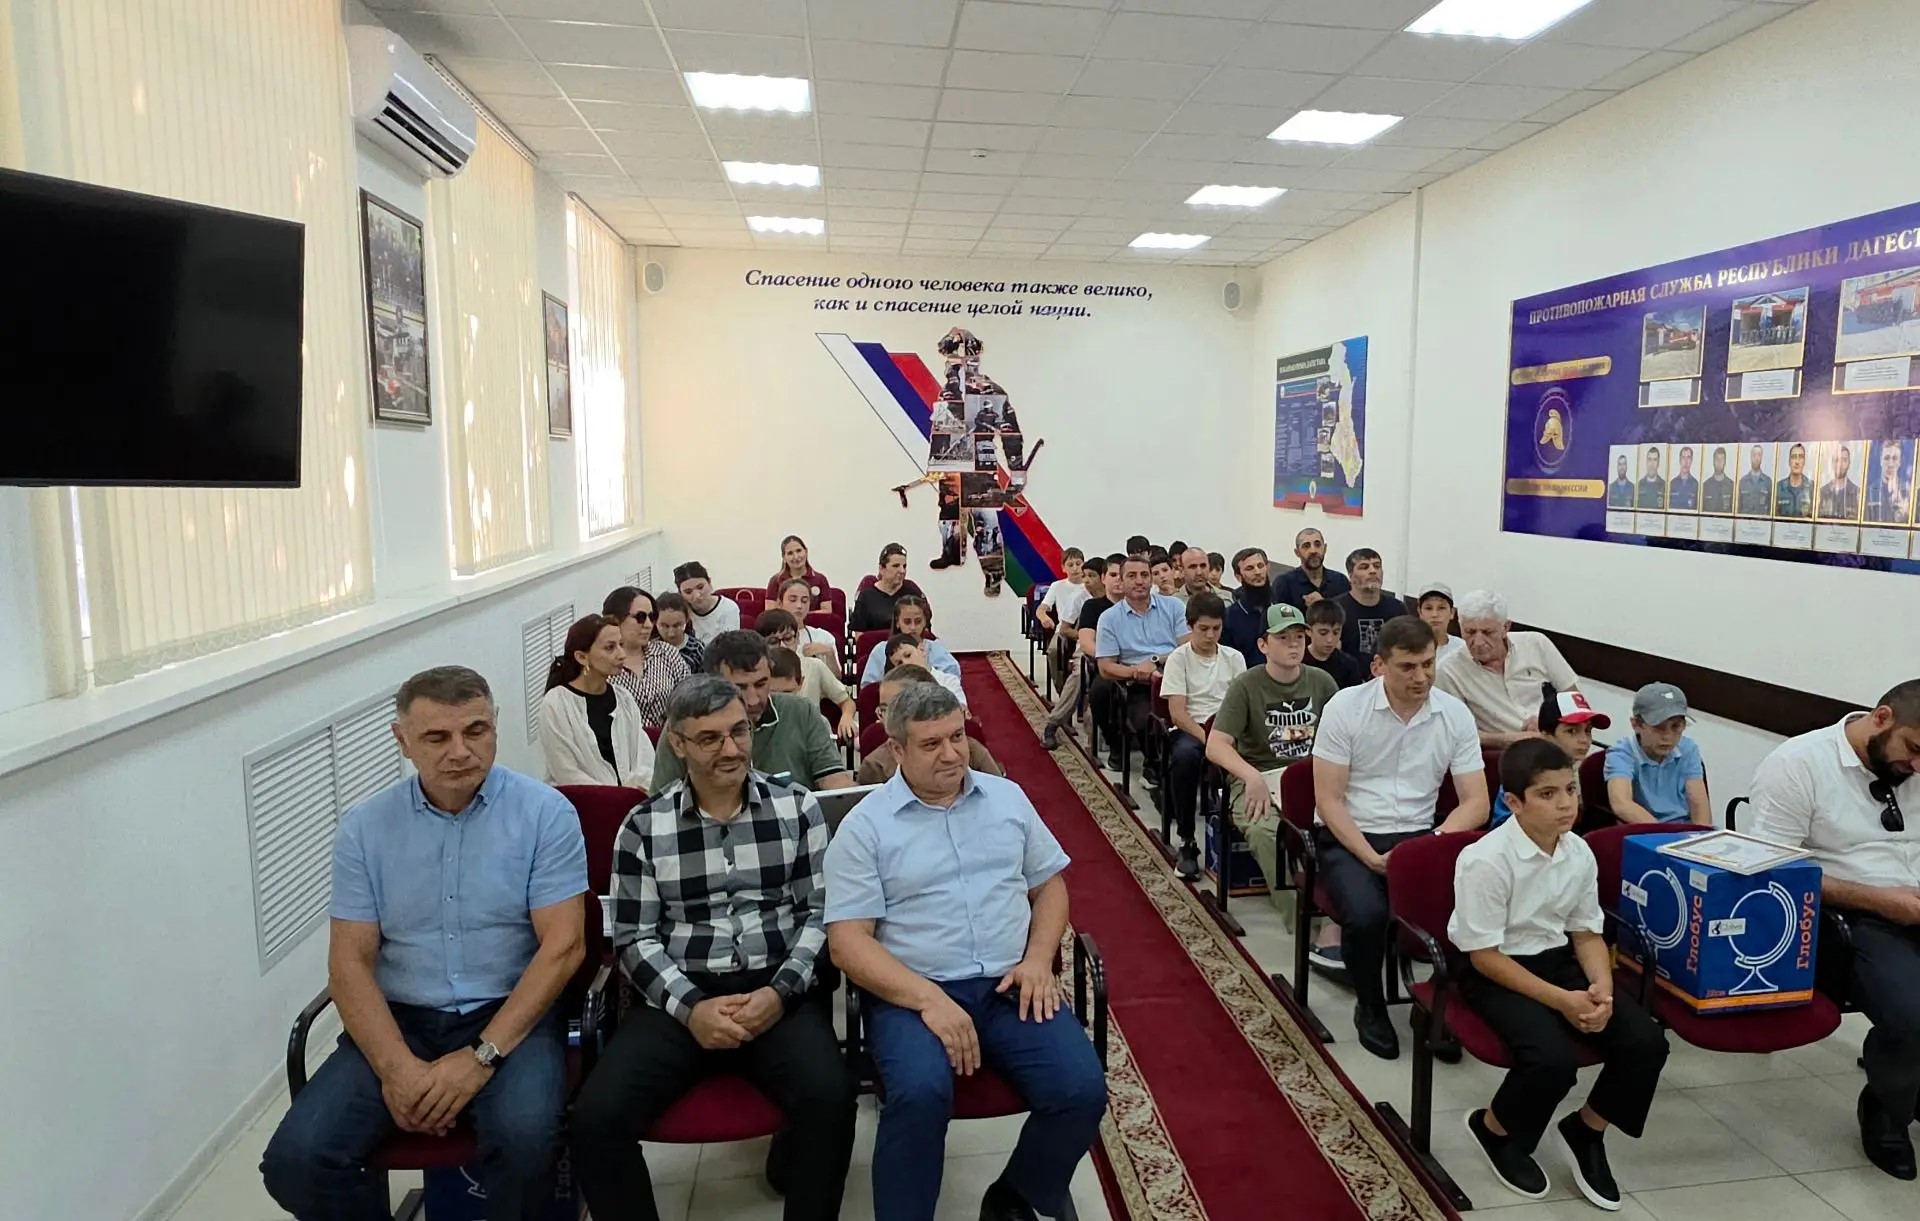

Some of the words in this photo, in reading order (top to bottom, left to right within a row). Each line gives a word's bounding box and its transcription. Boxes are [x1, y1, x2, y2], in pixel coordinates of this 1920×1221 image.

[745, 269, 841, 288] Спасение
[846, 272, 914, 290] одного
[920, 278, 1005, 293] человека
[1011, 281, 1078, 295] также
[1084, 283, 1153, 300] велико,
[814, 298, 850, 311] как
[855, 300, 867, 311] и
[873, 300, 962, 314] спасение
[967, 300, 1023, 318] целой
[1030, 304, 1091, 320] нации.
[1528, 286, 1647, 325] ПРОТИВОПОЖАРНАЯ
[1650, 272, 1713, 300] СЛУЖБА
[1717, 246, 1839, 287] РЕСПУБЛИКИ
[1686, 895, 1703, 976] Глобус
[1797, 891, 1815, 970] Глобус
